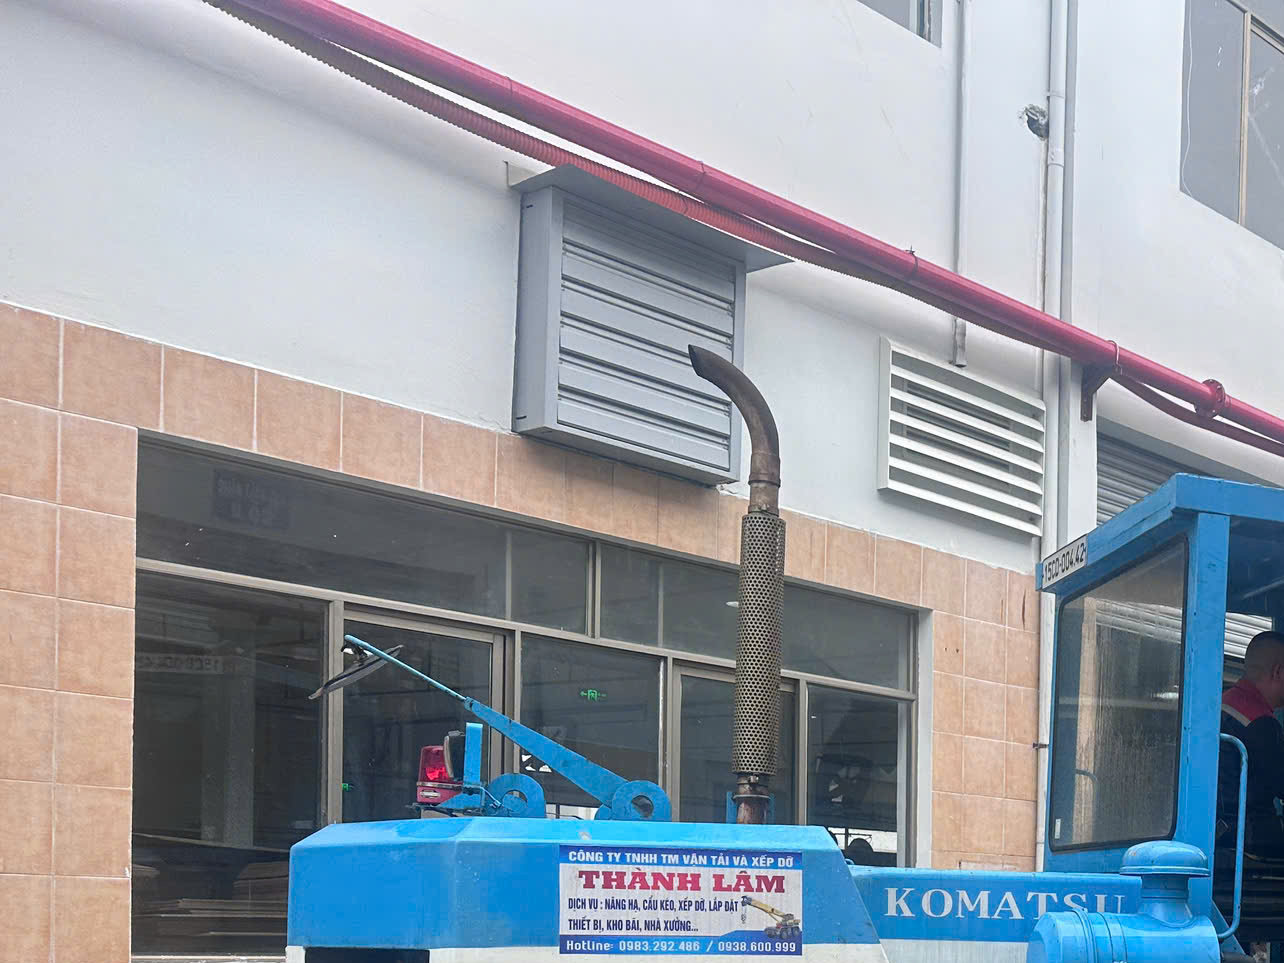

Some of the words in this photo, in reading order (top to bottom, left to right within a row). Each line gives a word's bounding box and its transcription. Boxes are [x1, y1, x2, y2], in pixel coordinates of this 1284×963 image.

[568, 849, 603, 863] CÔNG
[607, 852, 621, 863] TY
[625, 853, 658, 864] TNHH
[661, 854, 679, 864] TM
[683, 853, 707, 867] VẬN
[711, 853, 729, 866] TẢI
[732, 855, 748, 866] VÀ
[752, 854, 774, 867] XẾP
[578, 867, 701, 891] THÀNH
[712, 870, 785, 893] LÂM
[568, 898, 586, 912] DỊCH
[588, 898, 598, 912] VỤ
[604, 896, 626, 911] NÂNG
[884, 887, 1125, 920] KOMATSU
[568, 915, 591, 931] THIẾT
[607, 919, 623, 931] KHO
[566, 940, 614, 951] Hotline:
[619, 941, 700, 952] 0983.292.486
[718, 941, 796, 952] 0938.600.999
